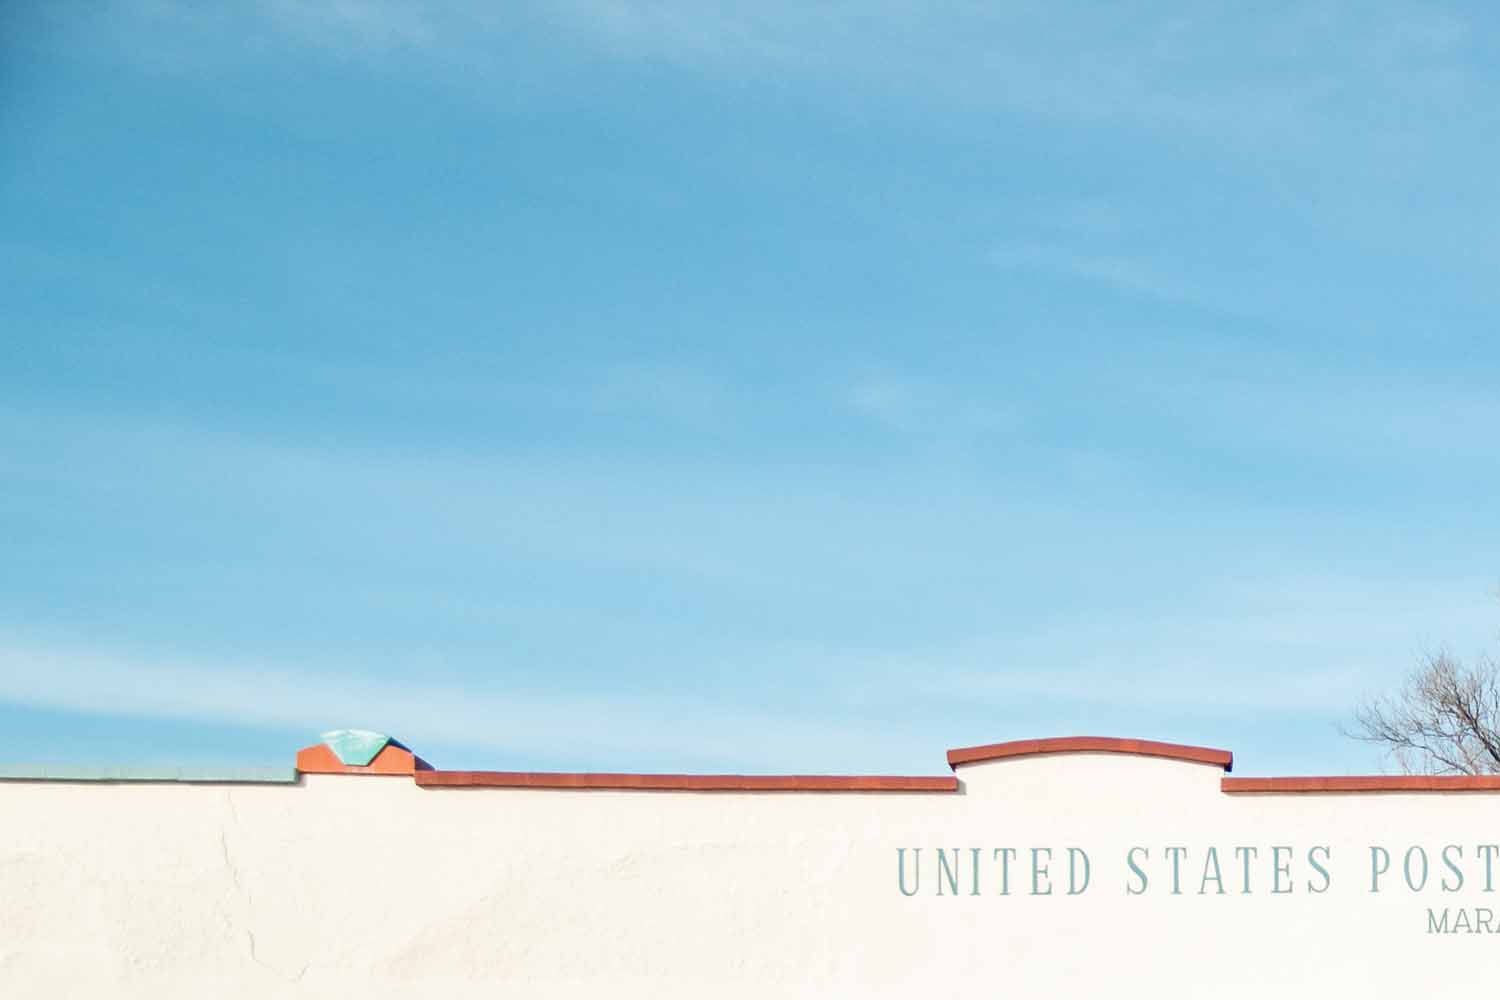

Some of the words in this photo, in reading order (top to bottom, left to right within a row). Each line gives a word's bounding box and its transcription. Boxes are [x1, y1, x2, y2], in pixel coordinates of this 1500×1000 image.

[896, 847, 1091, 897] UNITED
[1126, 845, 1331, 896] STATES
[1368, 844, 1500, 893] POST
